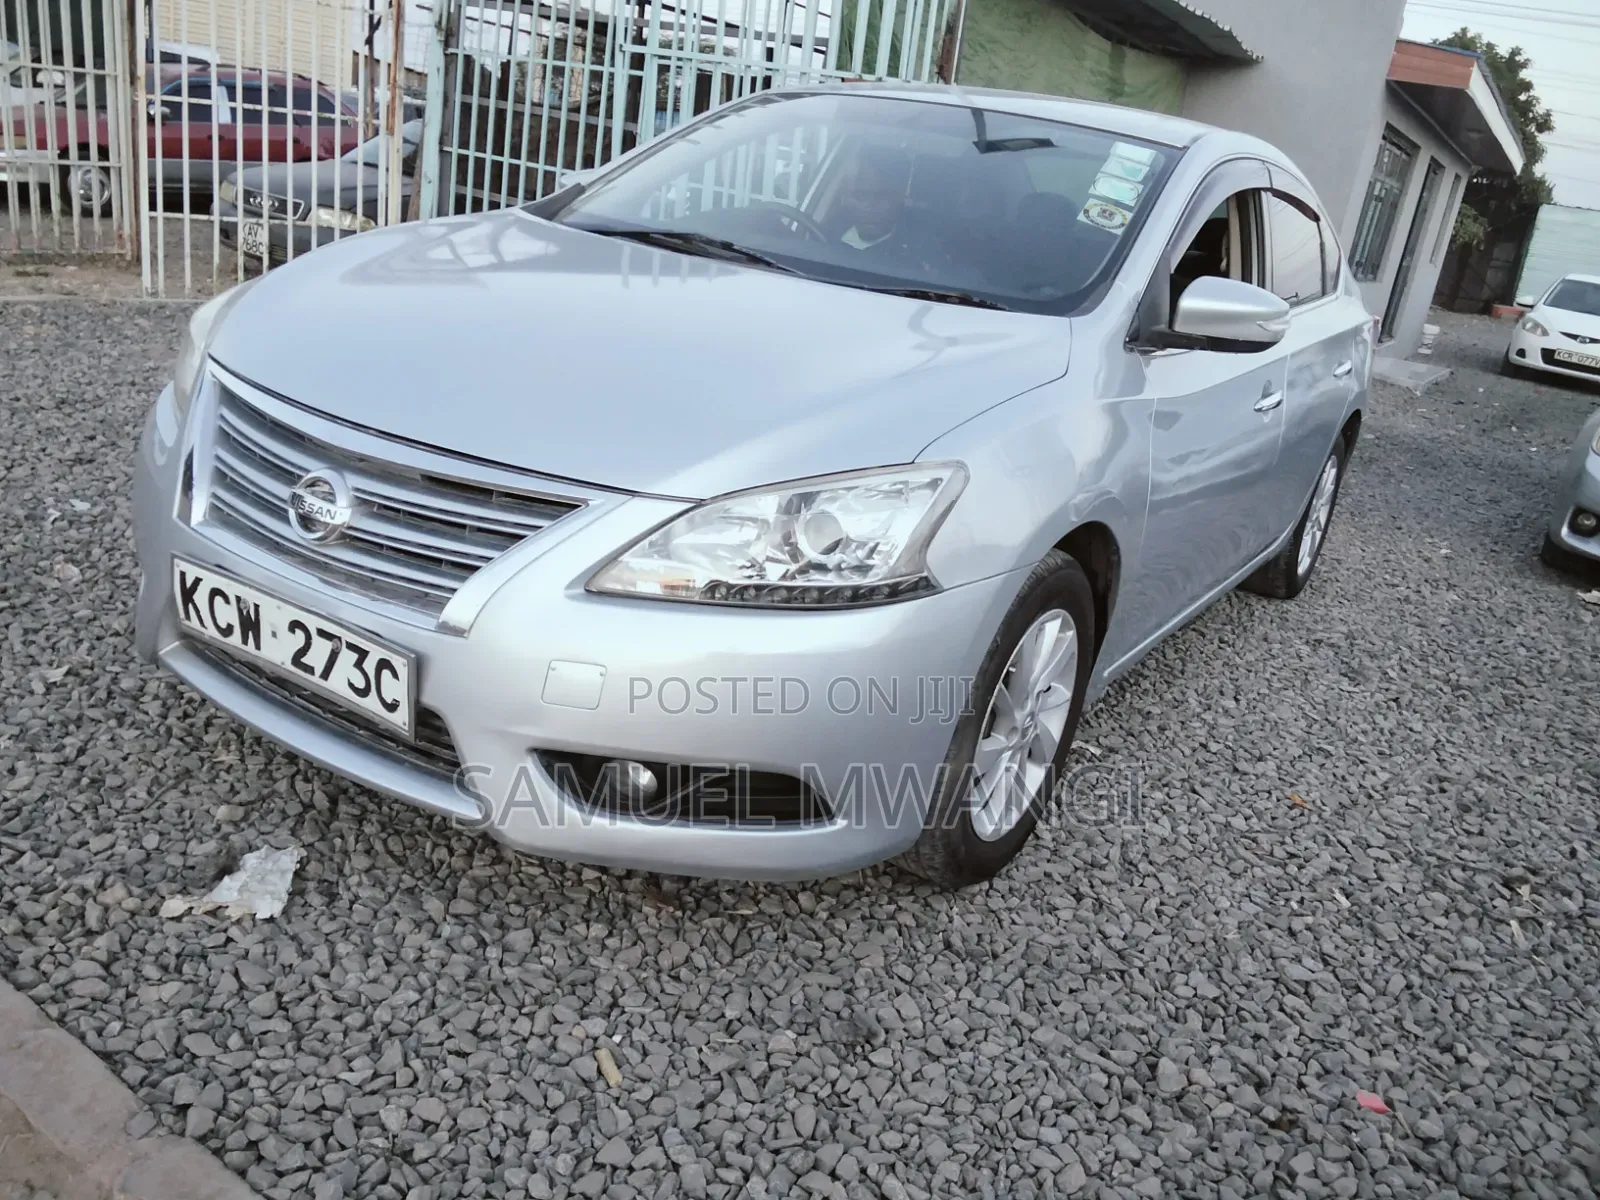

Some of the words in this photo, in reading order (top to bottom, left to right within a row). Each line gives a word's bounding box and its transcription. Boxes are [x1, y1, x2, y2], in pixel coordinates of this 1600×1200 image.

[1556, 350, 1574, 362] KCR
[291, 491, 338, 521] NISSAN
[179, 570, 262, 651] KCW
[287, 619, 401, 713] 273C
